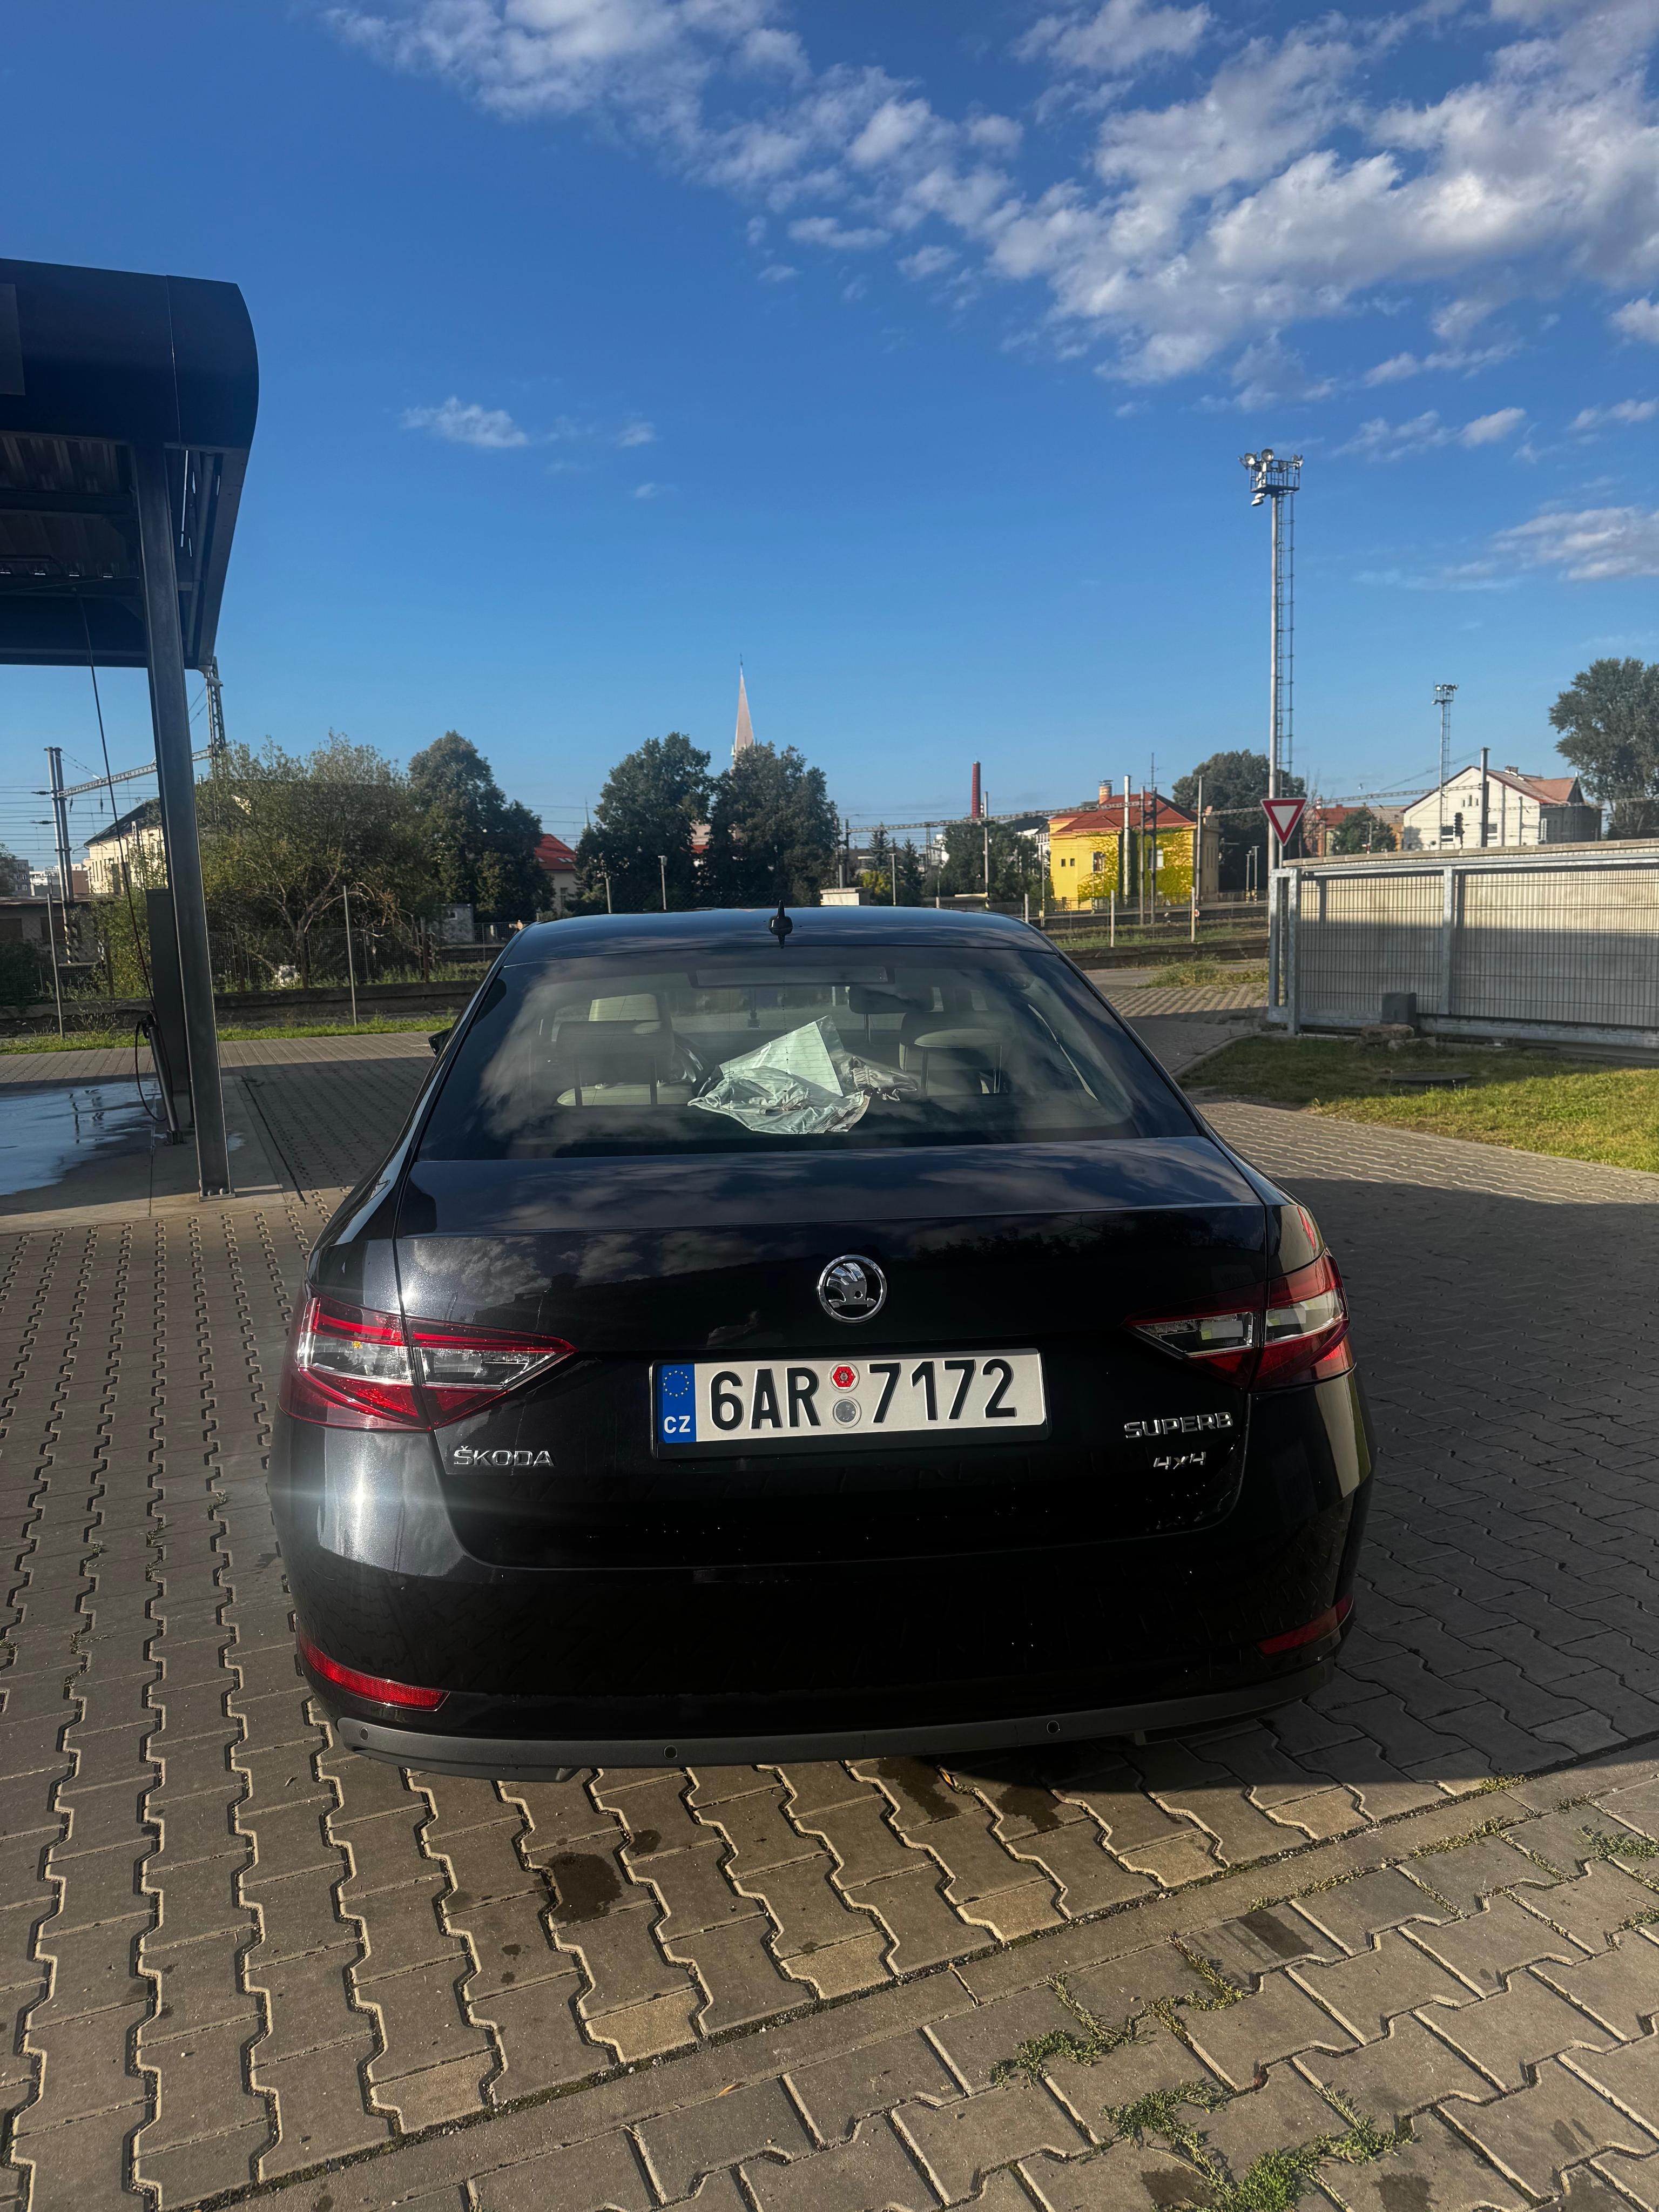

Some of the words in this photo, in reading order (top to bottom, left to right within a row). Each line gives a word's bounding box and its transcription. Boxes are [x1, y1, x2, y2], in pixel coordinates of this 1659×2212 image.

[710, 1367, 820, 1431] 6AR
[869, 1358, 1017, 1424] 7172
[664, 1415, 691, 1433] CZ
[1124, 1412, 1233, 1438] SUPERB
[454, 1446, 554, 1467] ŠKODA
